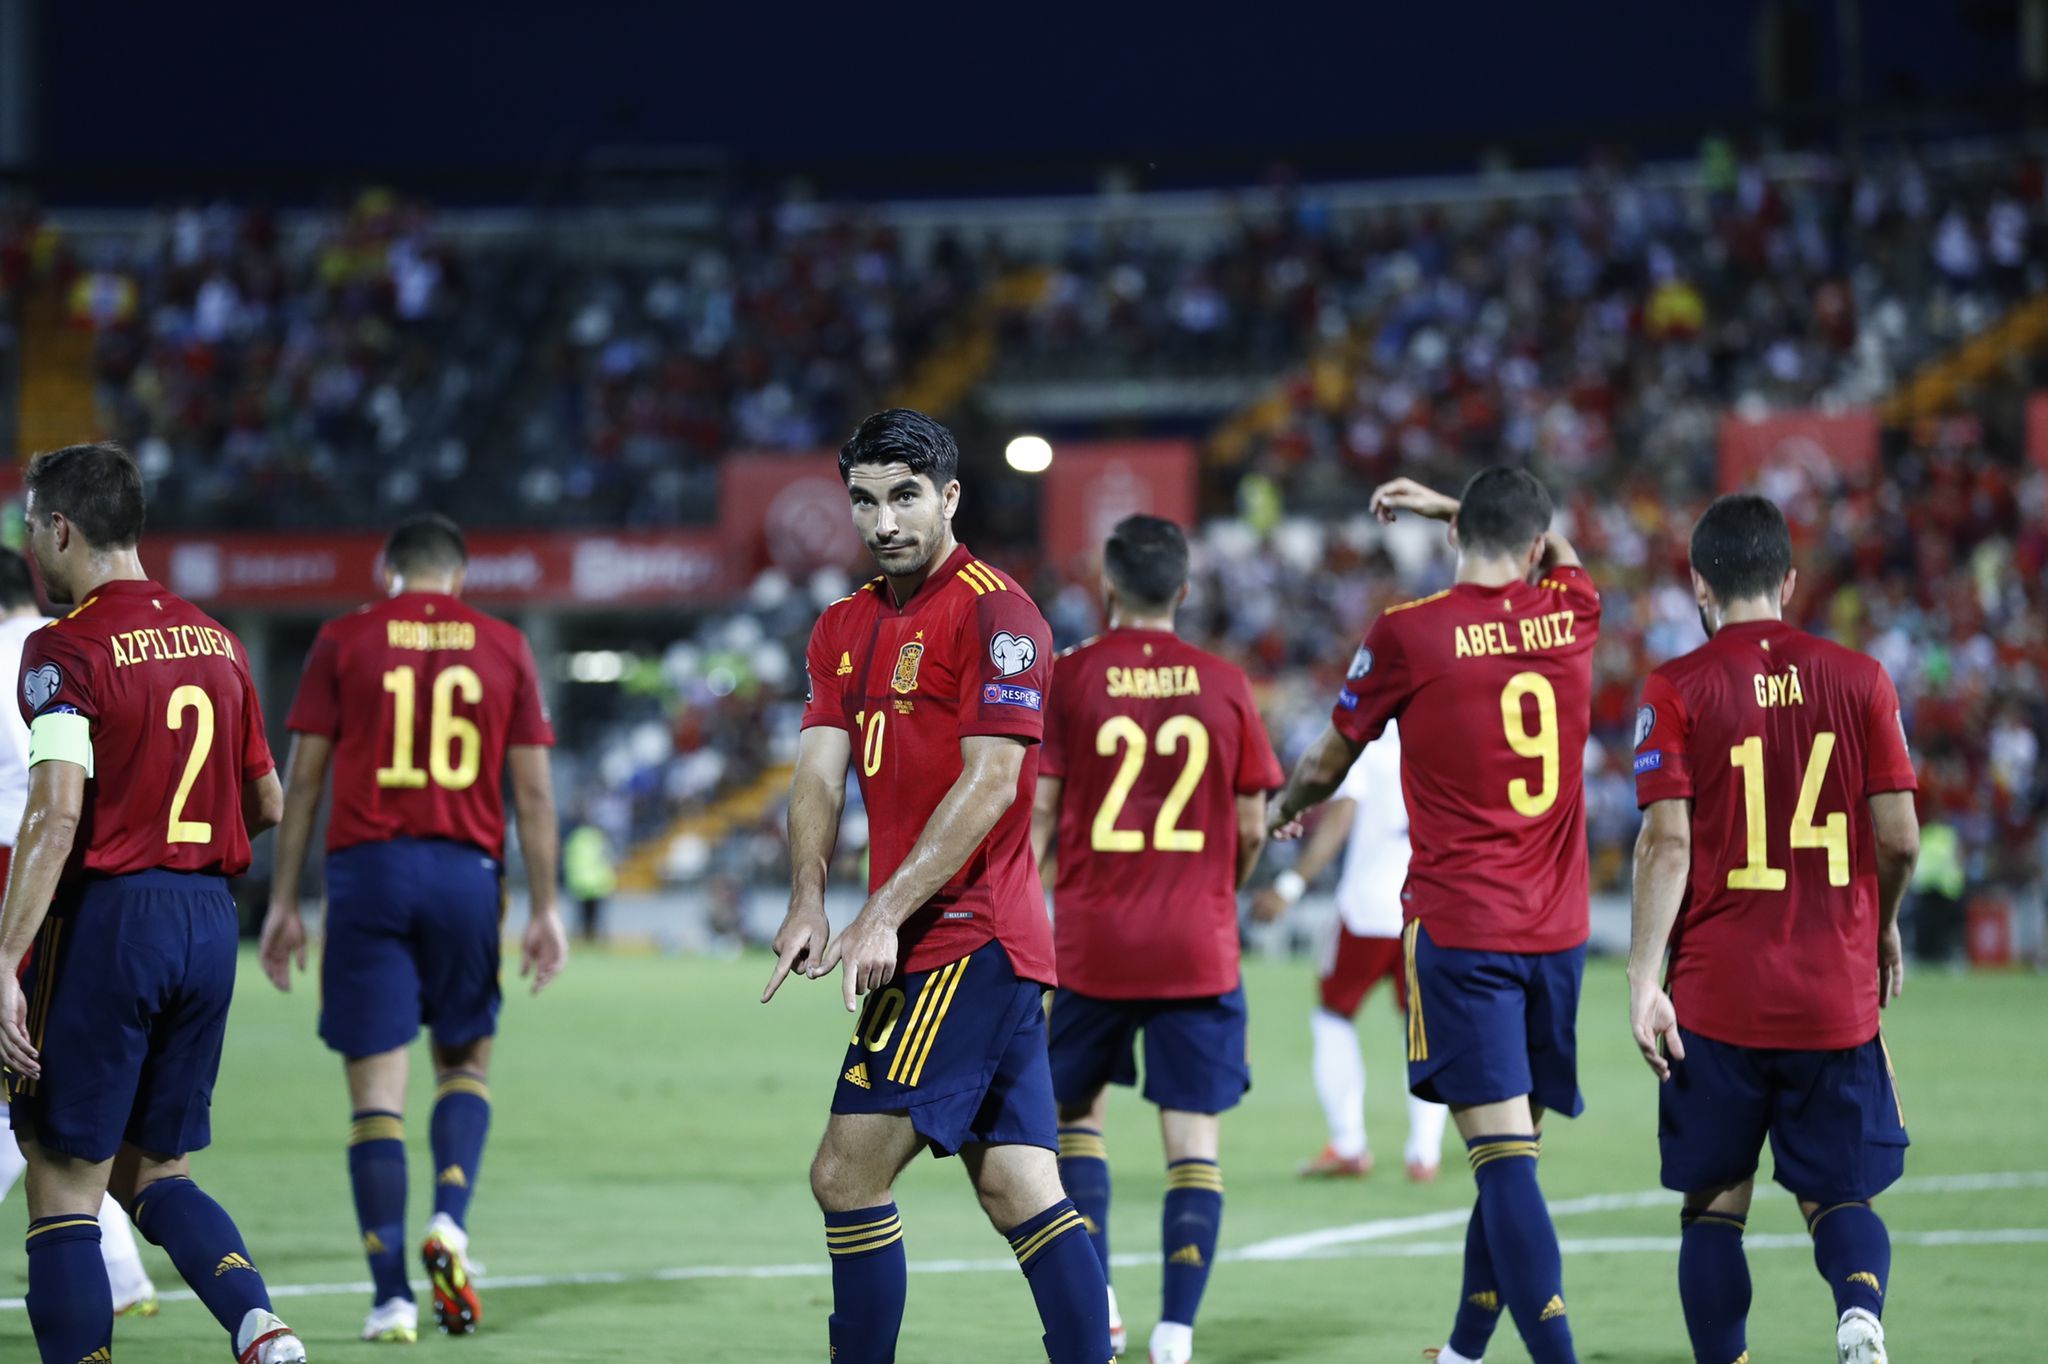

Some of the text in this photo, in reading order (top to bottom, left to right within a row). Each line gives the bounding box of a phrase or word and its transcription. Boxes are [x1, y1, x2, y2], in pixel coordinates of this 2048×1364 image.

[1455, 610, 1576, 658] ABEL RUIZ
[1001, 690, 1040, 705] RESPECT
[1106, 665, 1200, 699] SARABIA
[1754, 664, 1803, 707] GAYÀ
[167, 685, 214, 843] 2
[377, 665, 482, 789] 16
[1501, 672, 1559, 817] 9
[1092, 715, 1209, 852] 22
[1727, 732, 1849, 890] 14
[844, 1072, 872, 1090] adidas
